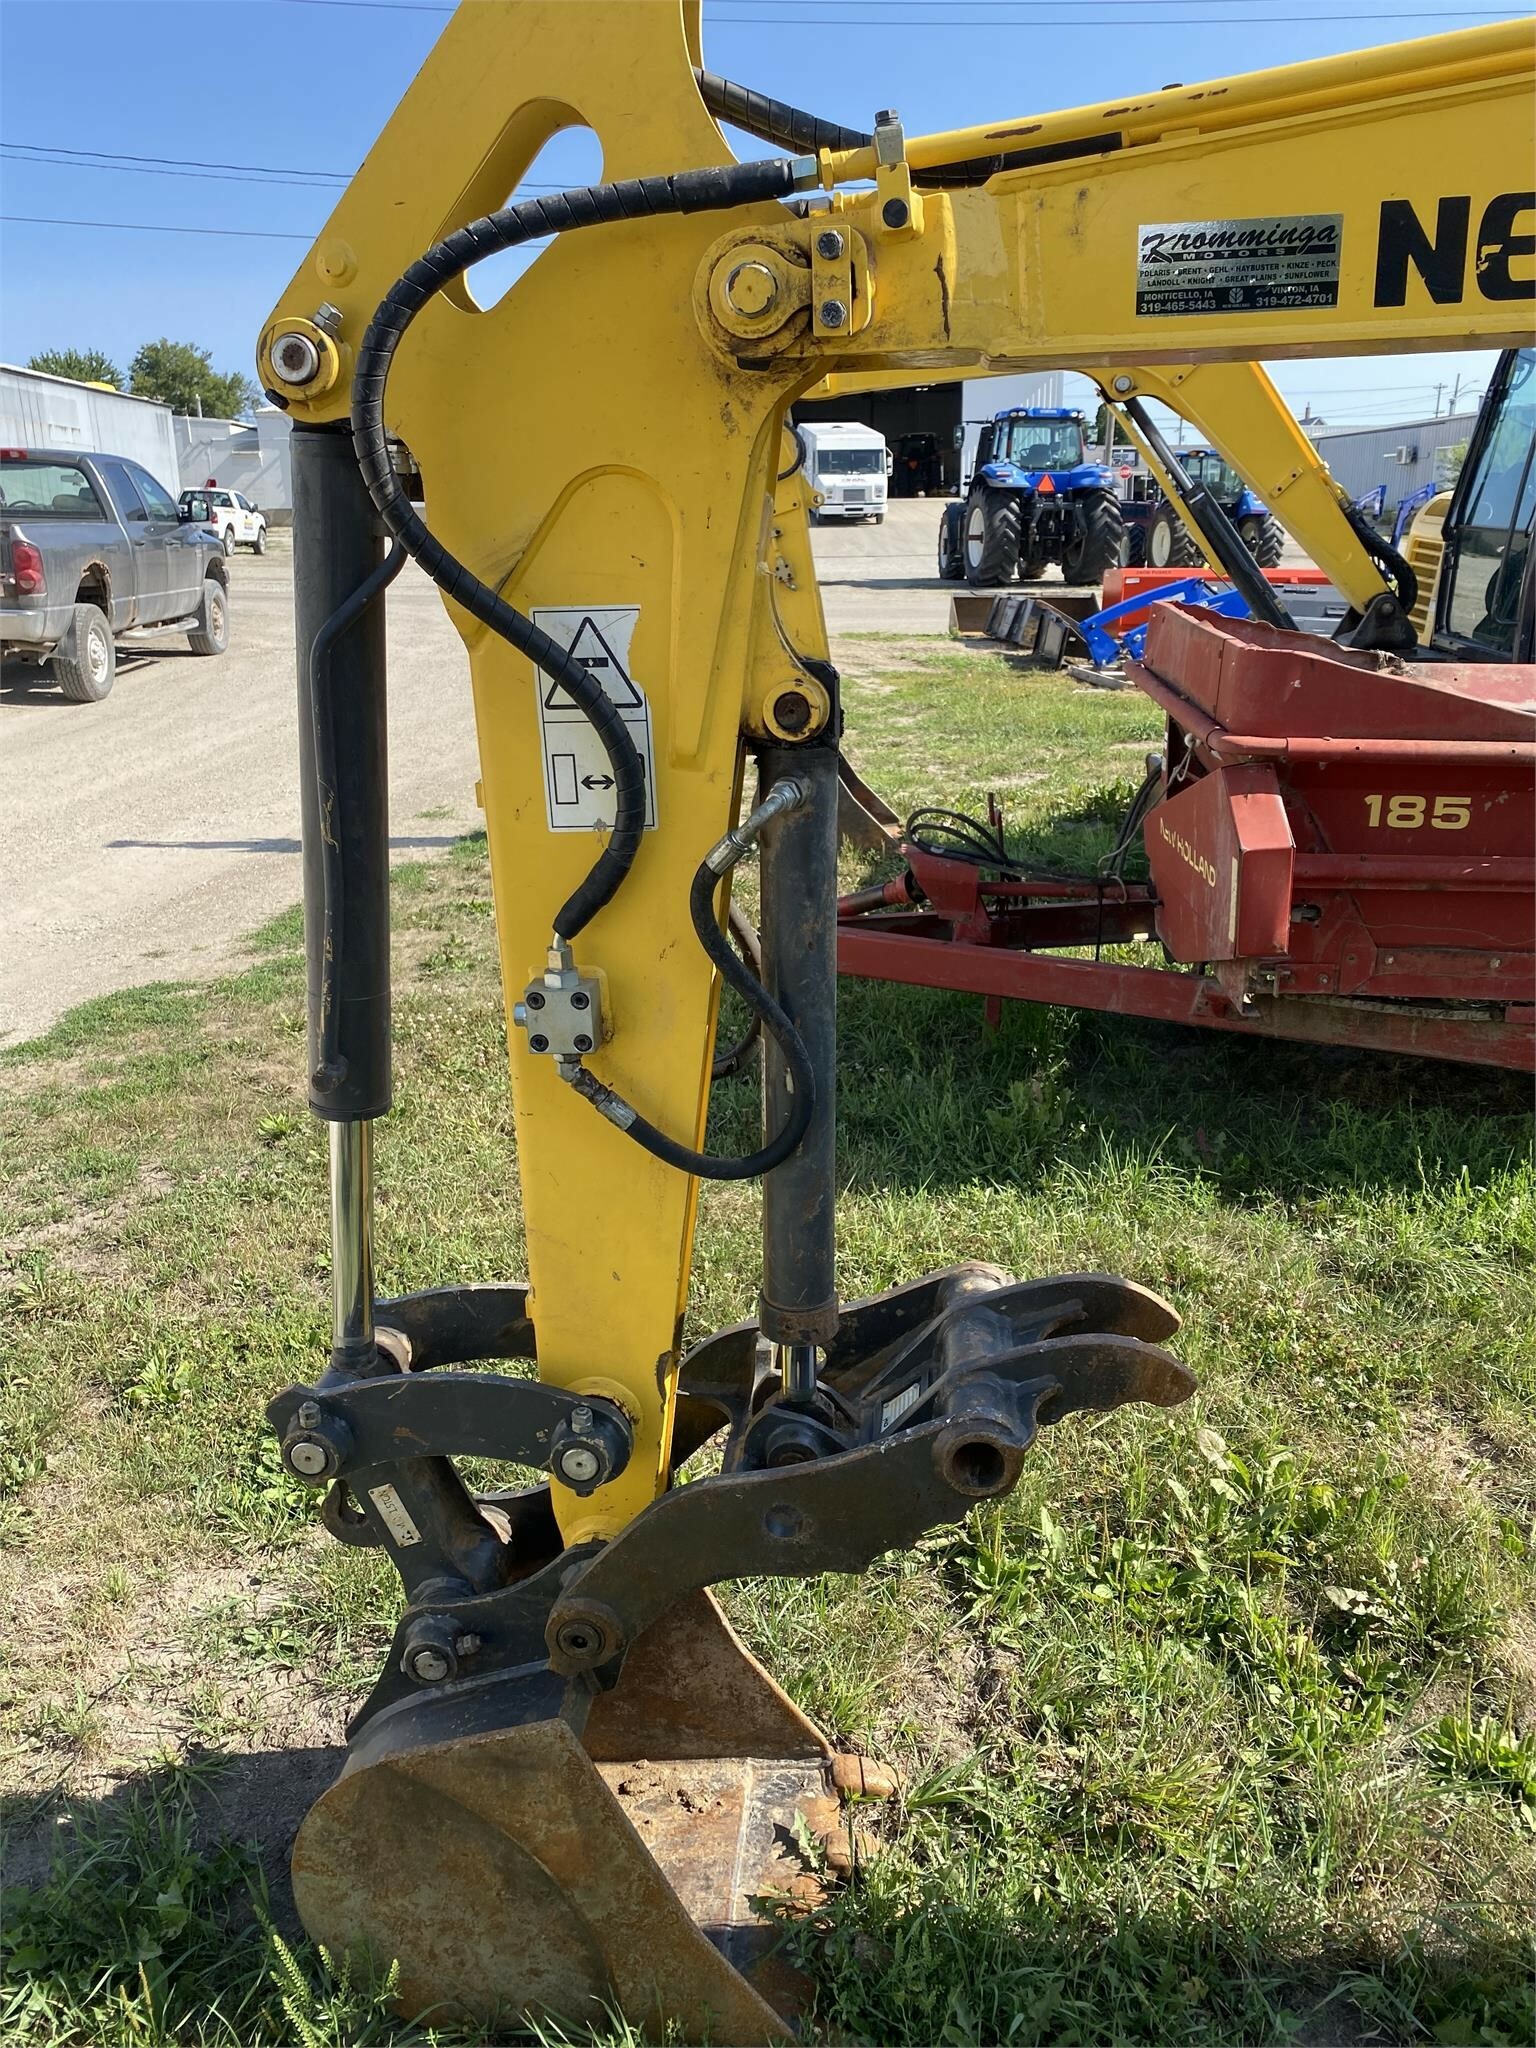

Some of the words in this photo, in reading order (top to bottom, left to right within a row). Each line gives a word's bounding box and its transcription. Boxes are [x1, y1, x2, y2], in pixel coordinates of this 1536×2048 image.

[1142, 223, 1340, 264] Kromminga
[1183, 247, 1286, 260] MOTORS
[1140, 268, 1171, 278] POLARIS
[1209, 266, 1229, 274] GEHL
[1236, 263, 1280, 272] HAYBUSTER
[1287, 261, 1310, 270] KINZE
[1316, 260, 1337, 268] PECK
[1147, 279, 1181, 287] LANDOLL
[1187, 277, 1216, 285] KNIGHT
[1225, 275, 1249, 283] GREAT
[1251, 273, 1277, 282] PLAINS
[1284, 270, 1330, 279] SUNFLOWER
[1144, 291, 1202, 301] MONTICELLO,
[1204, 290, 1214, 298] IA
[1310, 284, 1320, 293] IA
[1140, 299, 1217, 313] 319-465-5443
[1255, 293, 1333, 307] 319-472-4701
[1364, 794, 1472, 830] 185
[1160, 817, 1176, 848] NEW
[1177, 834, 1216, 888] HOLLAND
